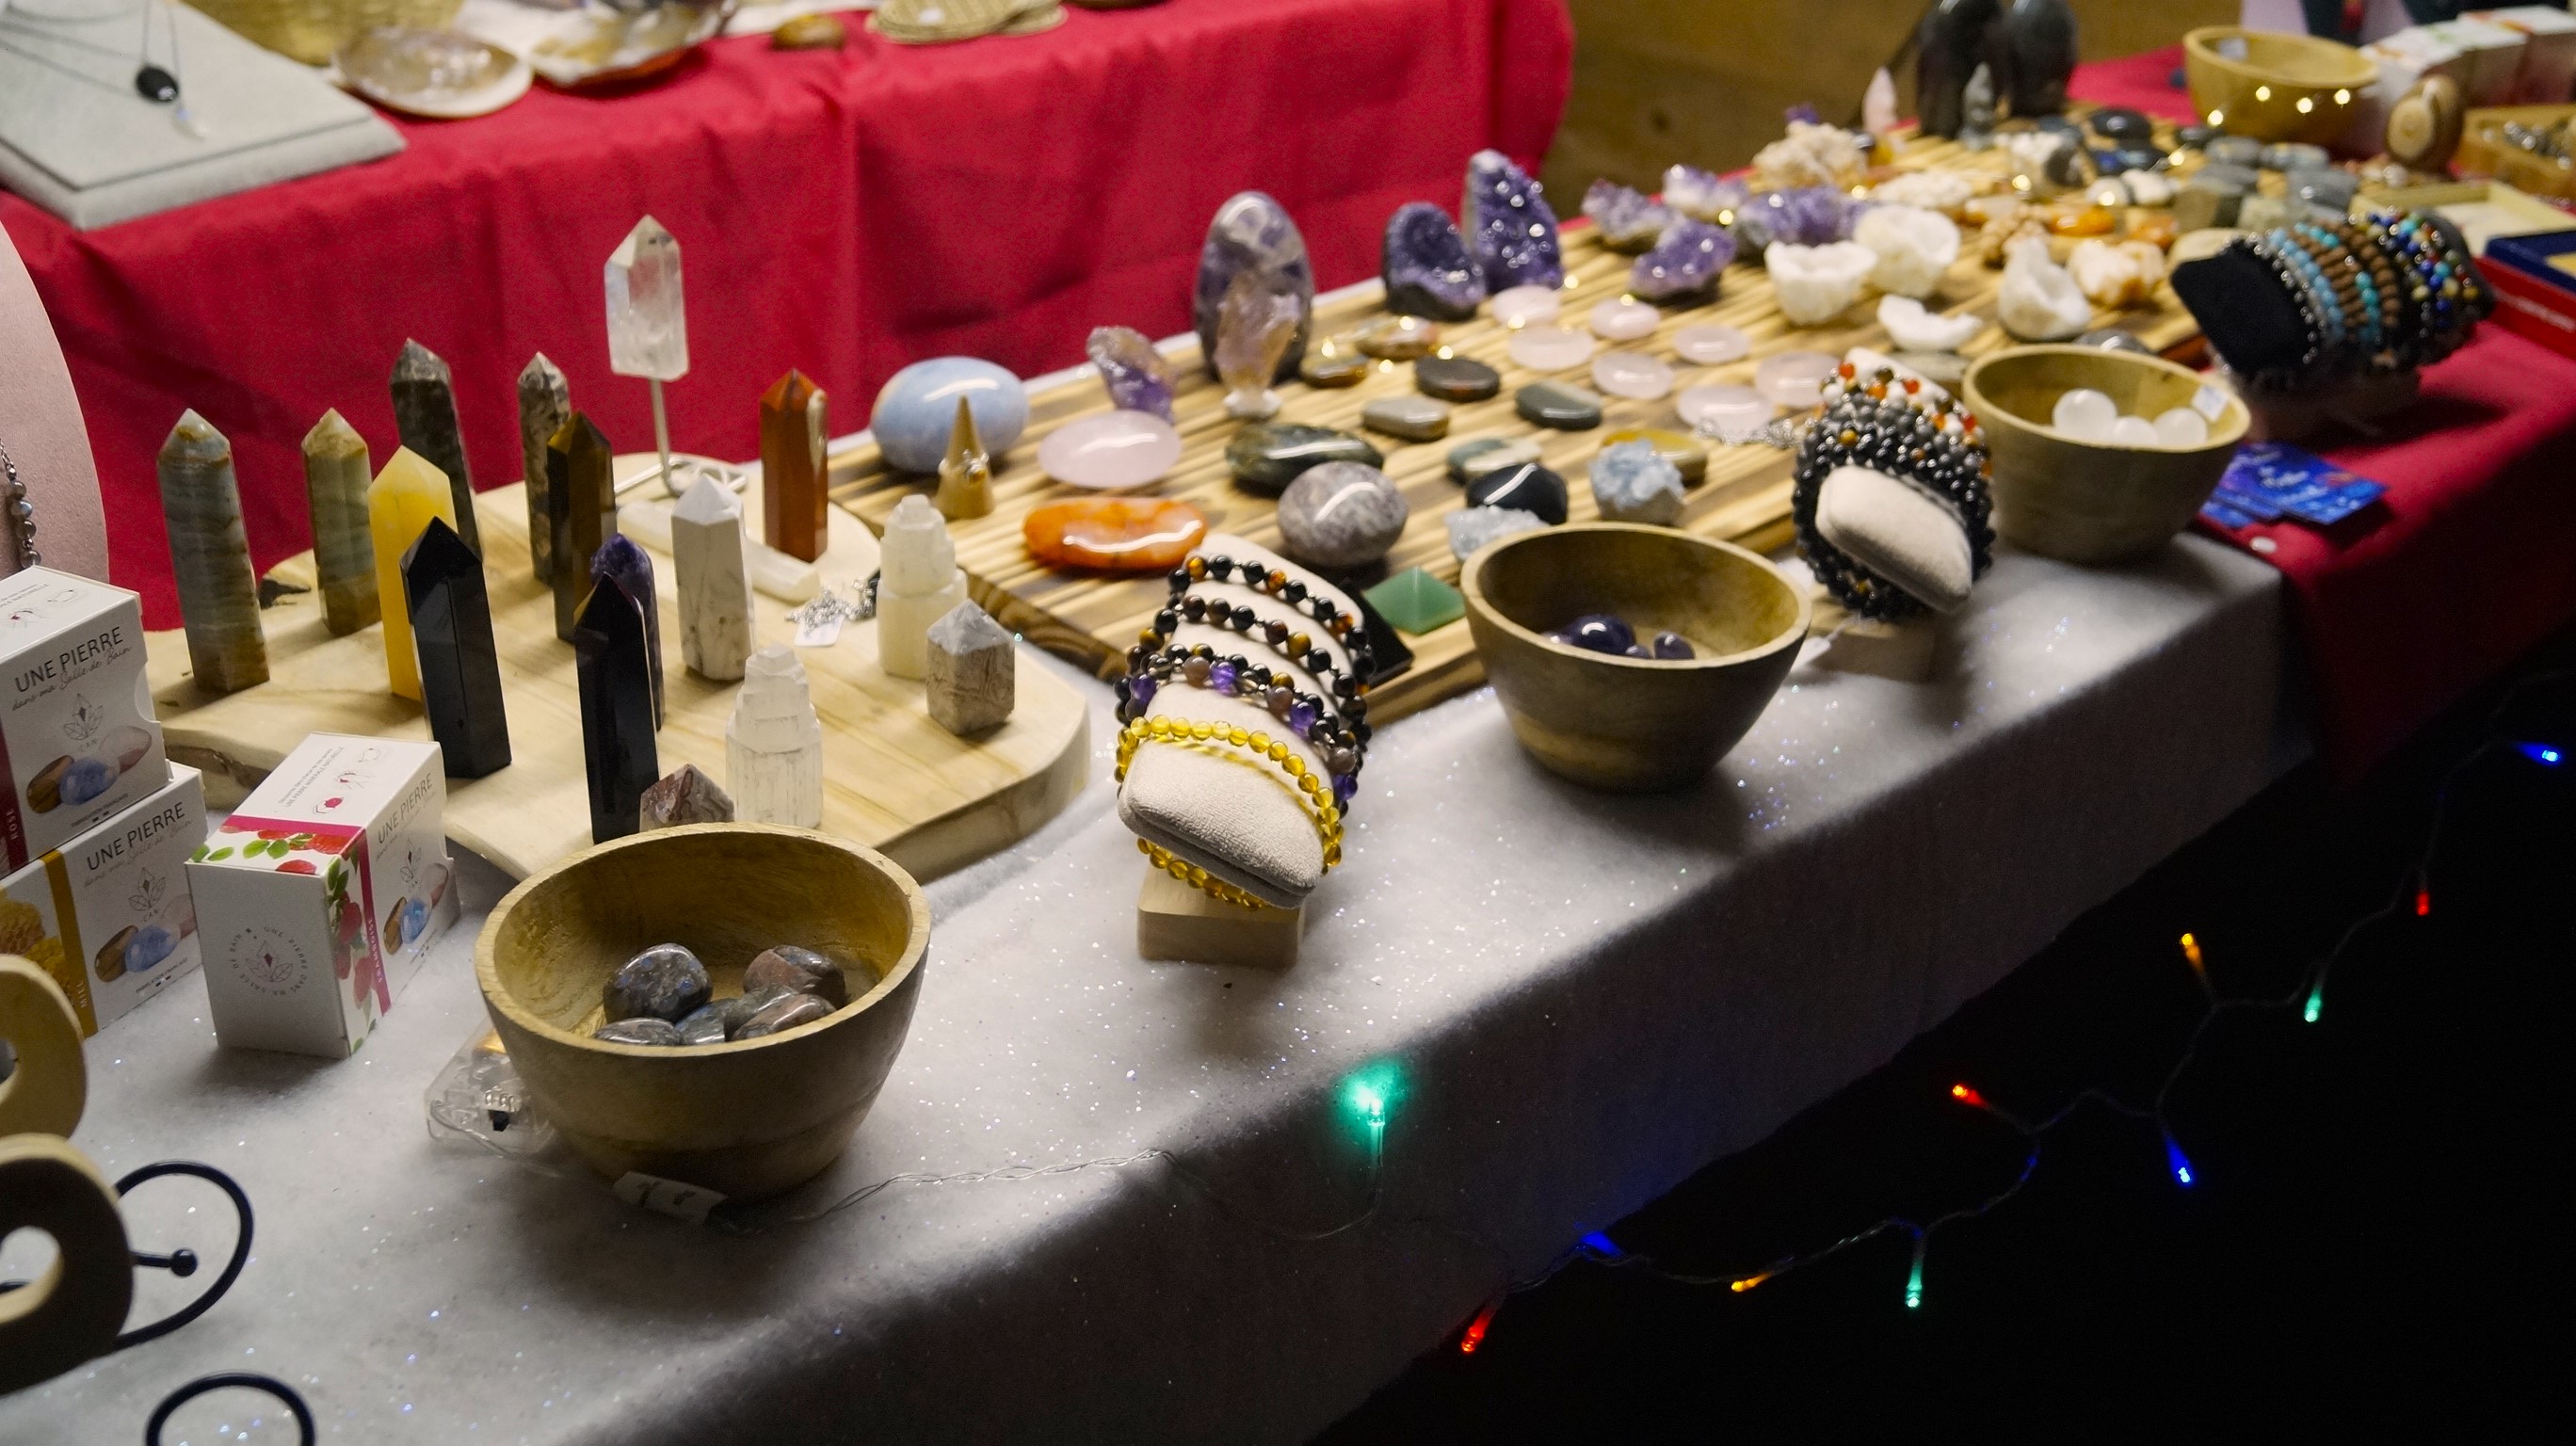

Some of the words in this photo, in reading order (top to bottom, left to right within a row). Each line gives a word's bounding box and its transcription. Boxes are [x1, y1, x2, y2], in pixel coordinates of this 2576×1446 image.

[15, 660, 56, 693] UNE
[59, 626, 123, 674] PIERRE
[87, 838, 125, 870] UNE
[126, 801, 185, 849] PIERRE
[378, 811, 399, 844] UNE
[400, 772, 434, 821] PIERRE
